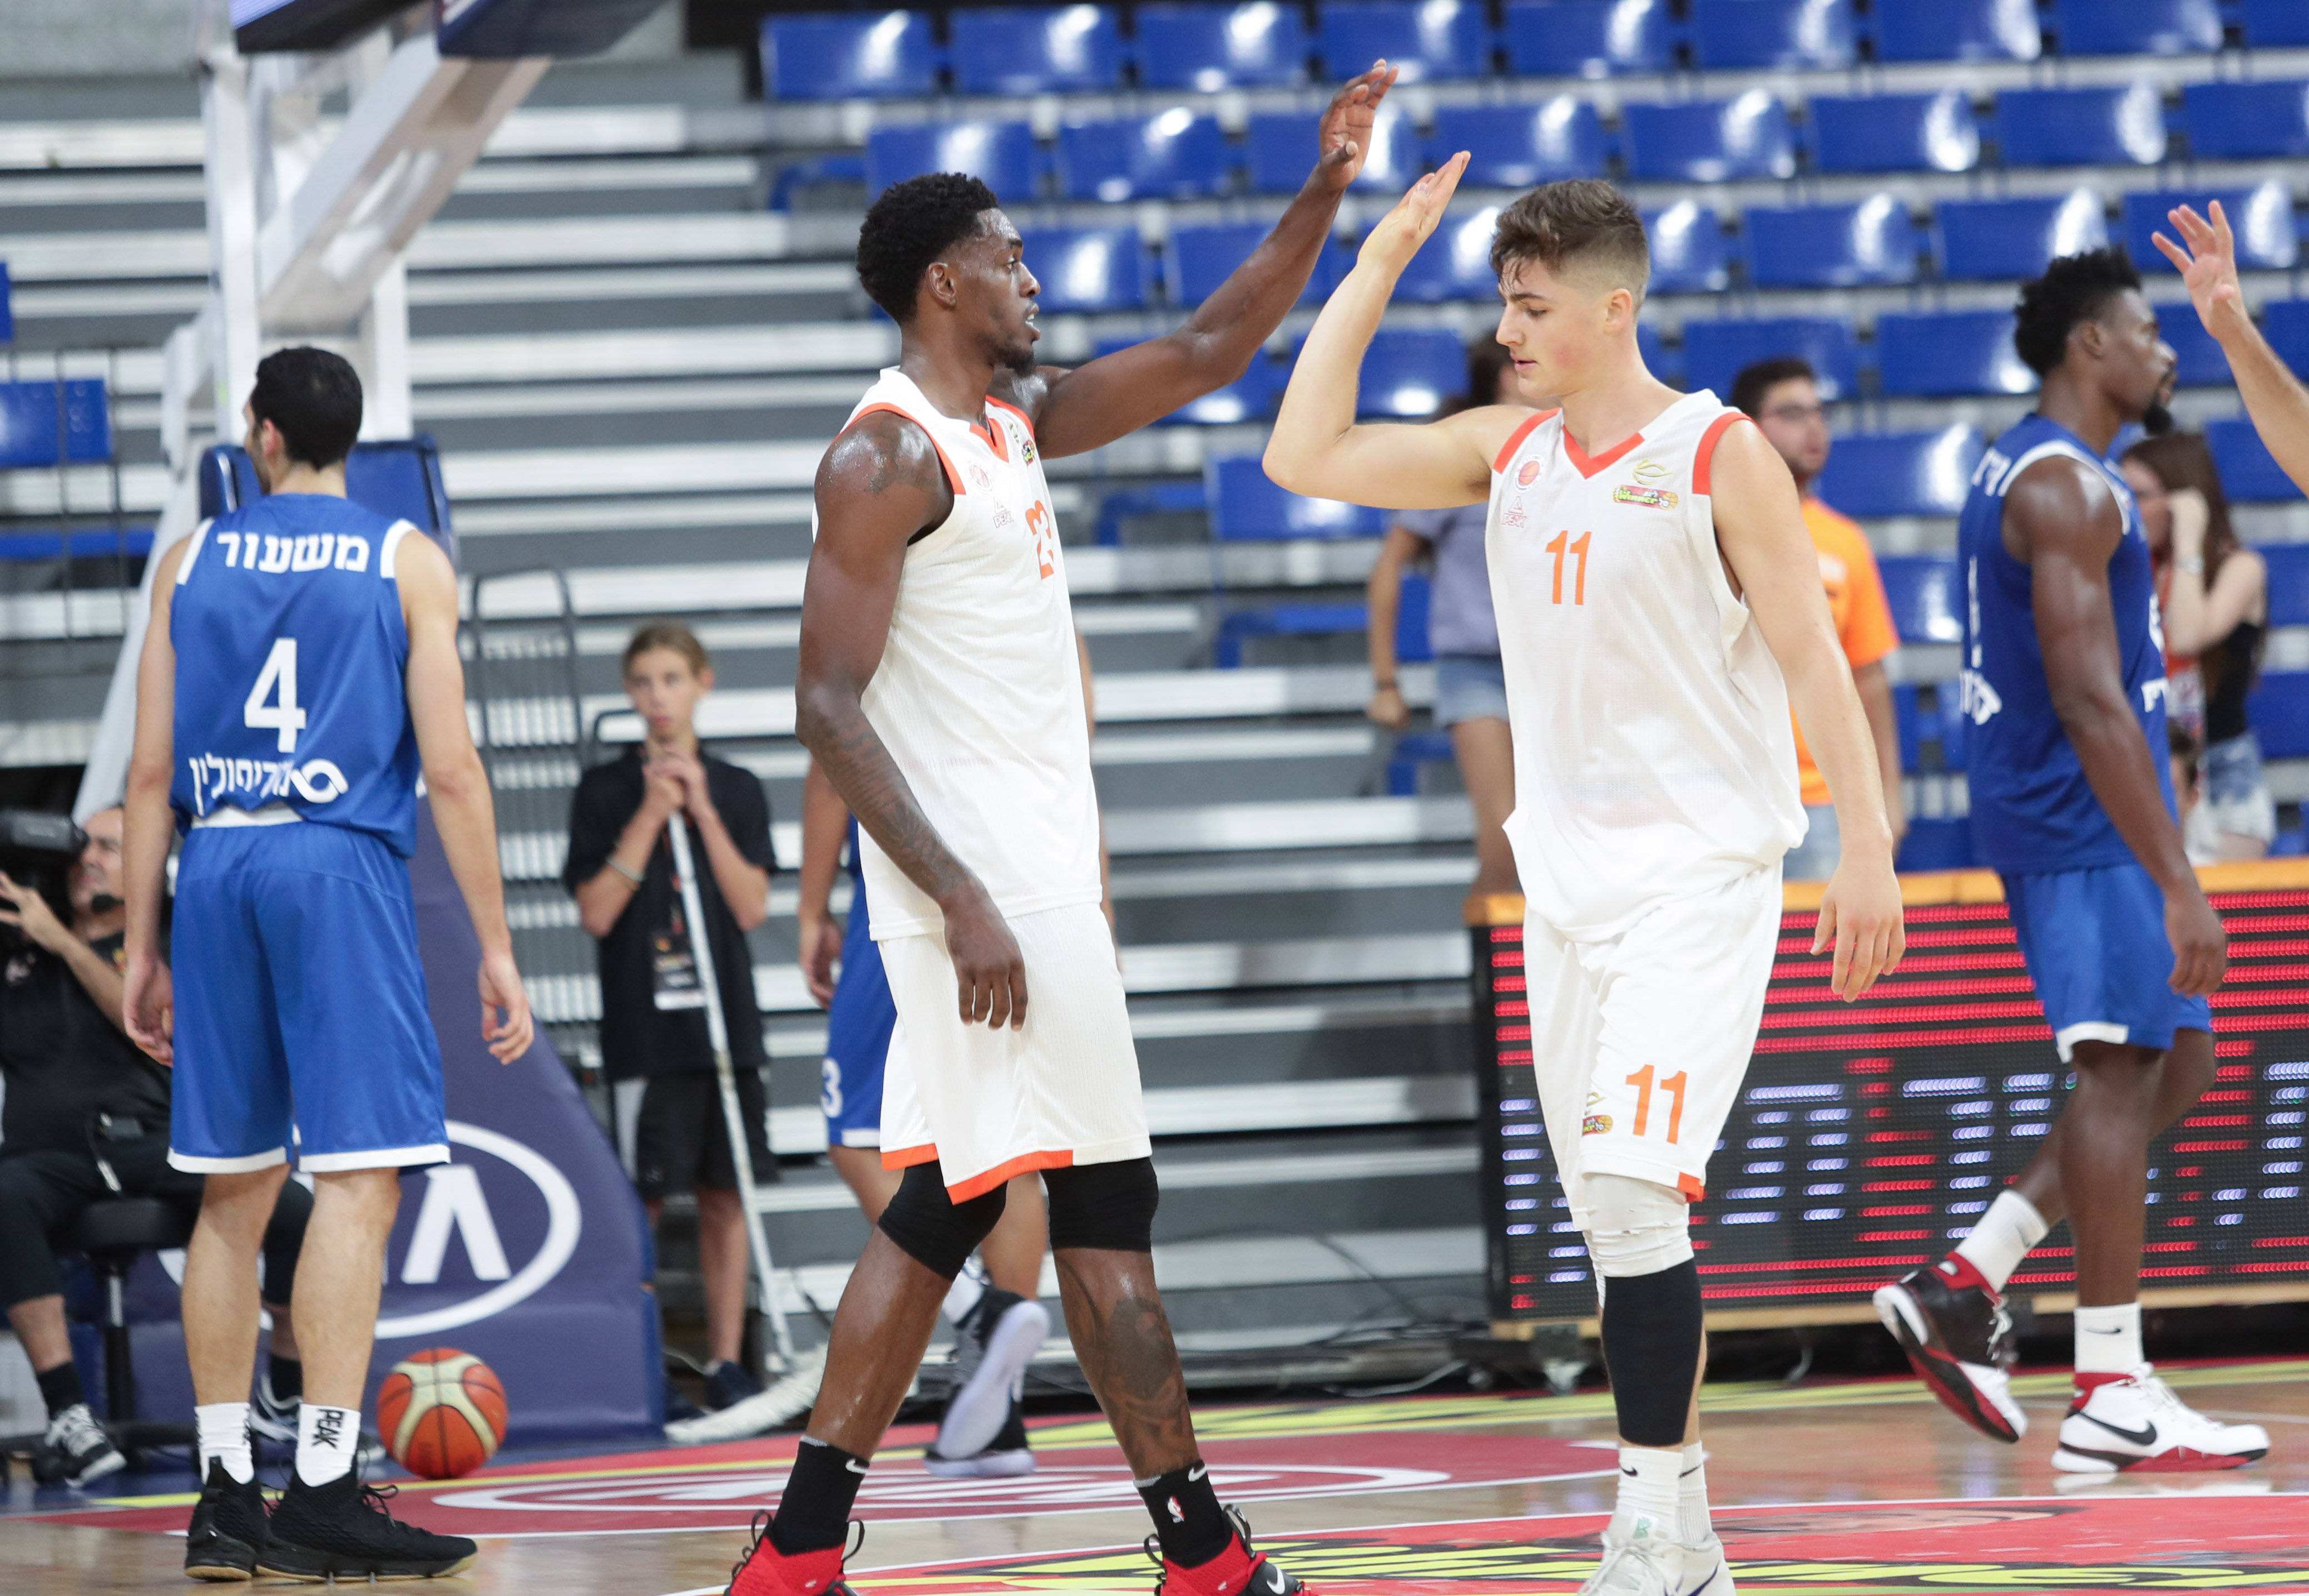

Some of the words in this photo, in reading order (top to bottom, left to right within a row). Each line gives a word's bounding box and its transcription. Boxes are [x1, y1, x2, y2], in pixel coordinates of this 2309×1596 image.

[993, 511, 1014, 528] PEAK
[216, 532, 370, 574] משעור
[1545, 530, 1591, 605] 11
[244, 638, 306, 753] 4
[1625, 1064, 1687, 1145] 11
[312, 1408, 345, 1450] PEAK
